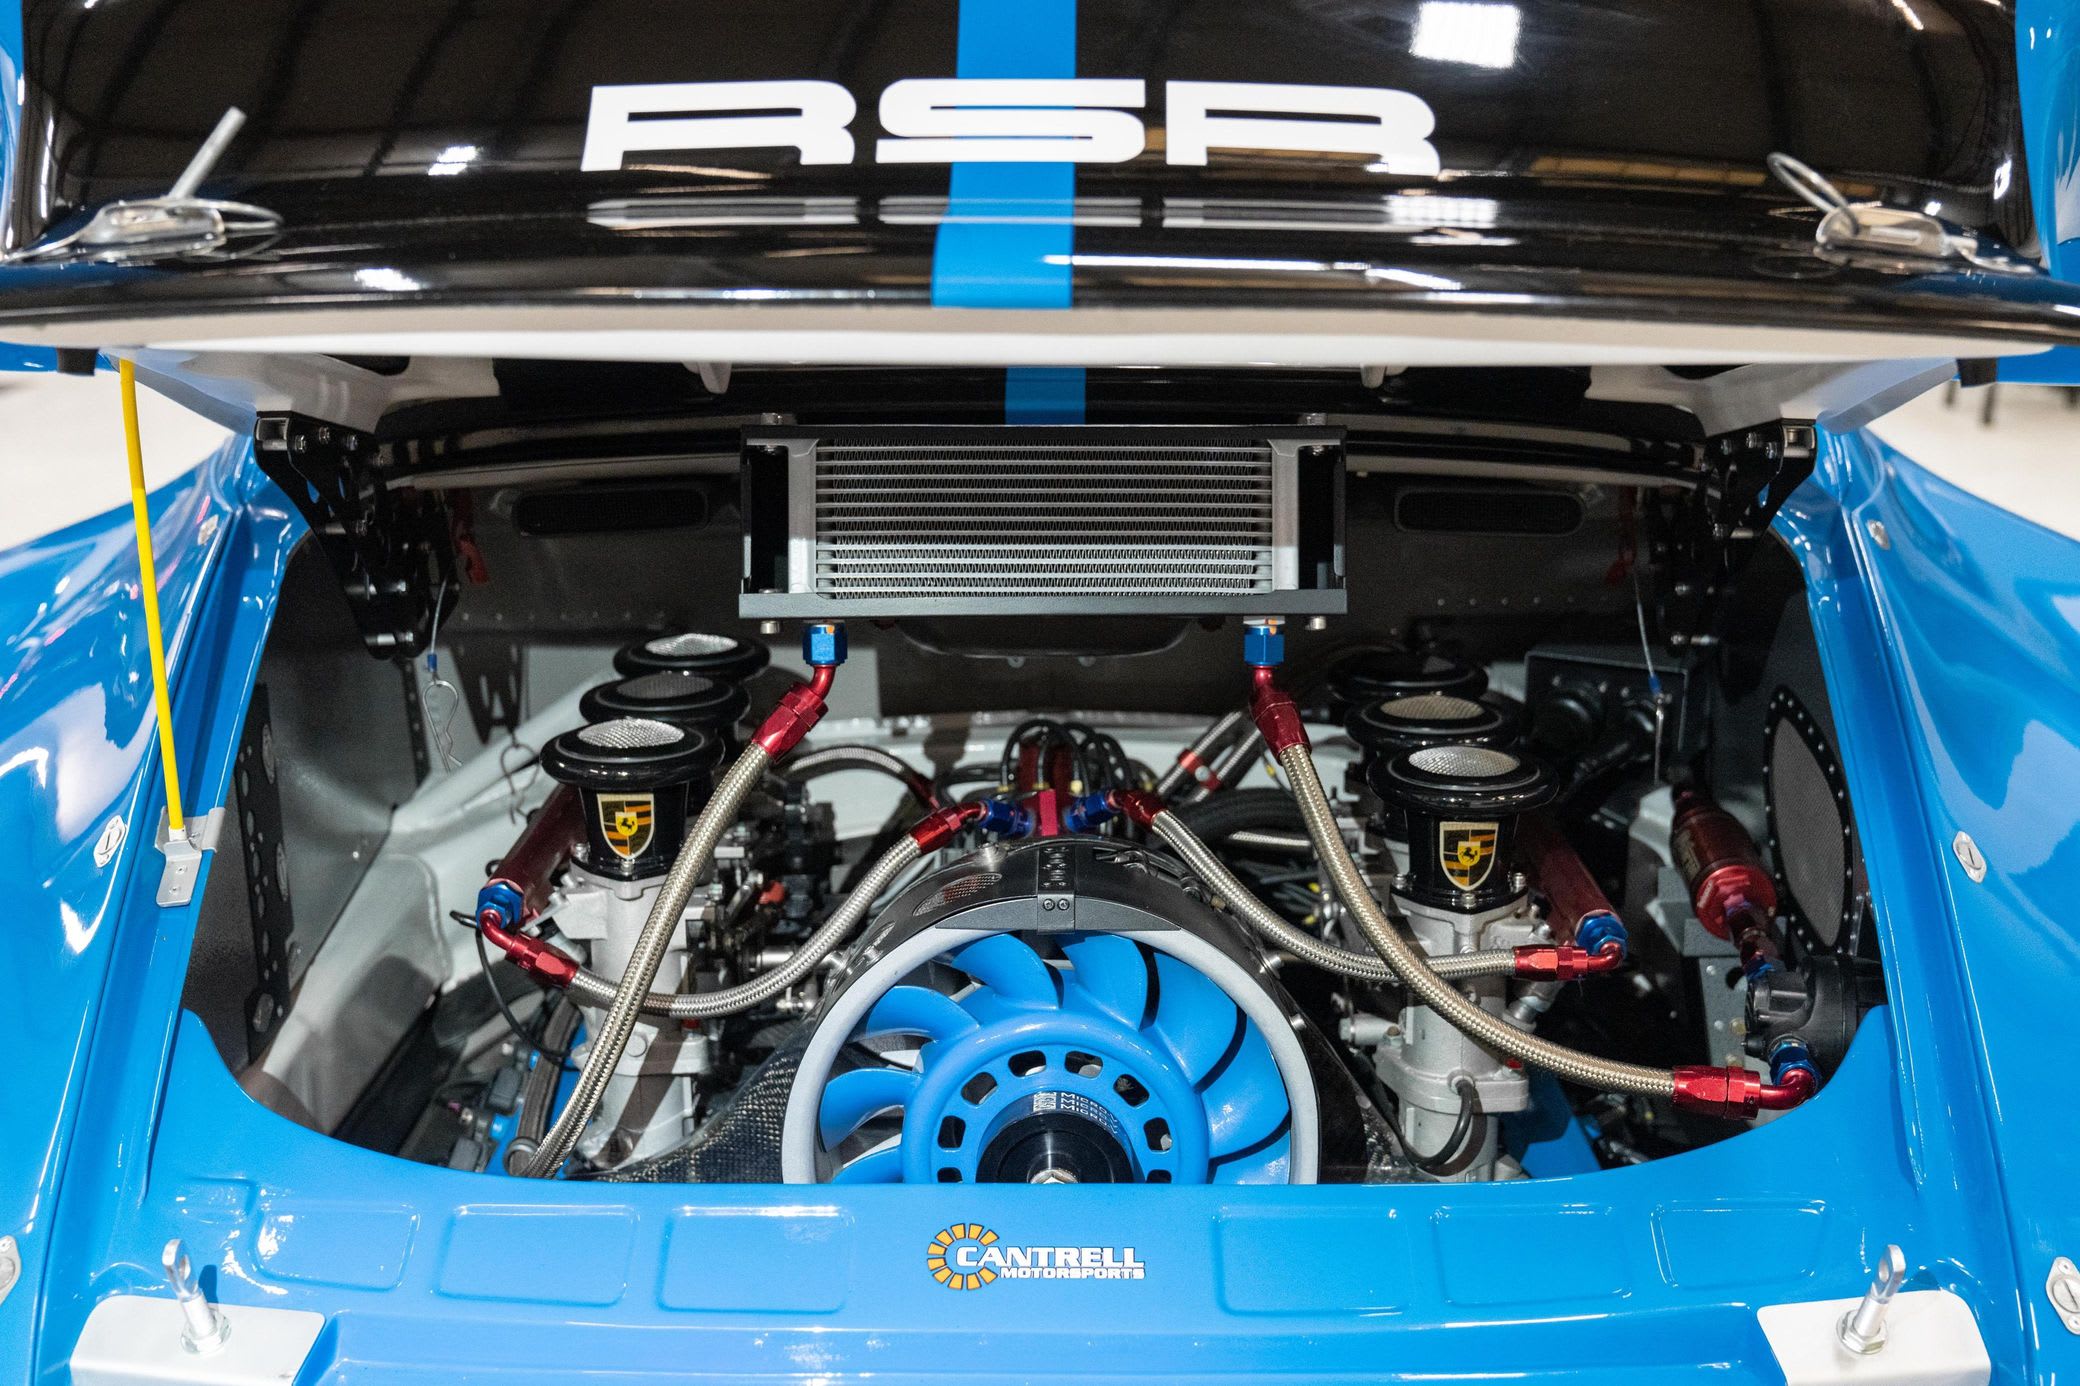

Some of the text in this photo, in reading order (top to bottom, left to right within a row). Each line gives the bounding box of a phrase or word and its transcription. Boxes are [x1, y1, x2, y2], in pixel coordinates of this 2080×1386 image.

[581, 78, 1441, 176] RSR
[956, 1246, 1145, 1267] CANTRELL
[1000, 1267, 1145, 1279] MOTORSPORTS
